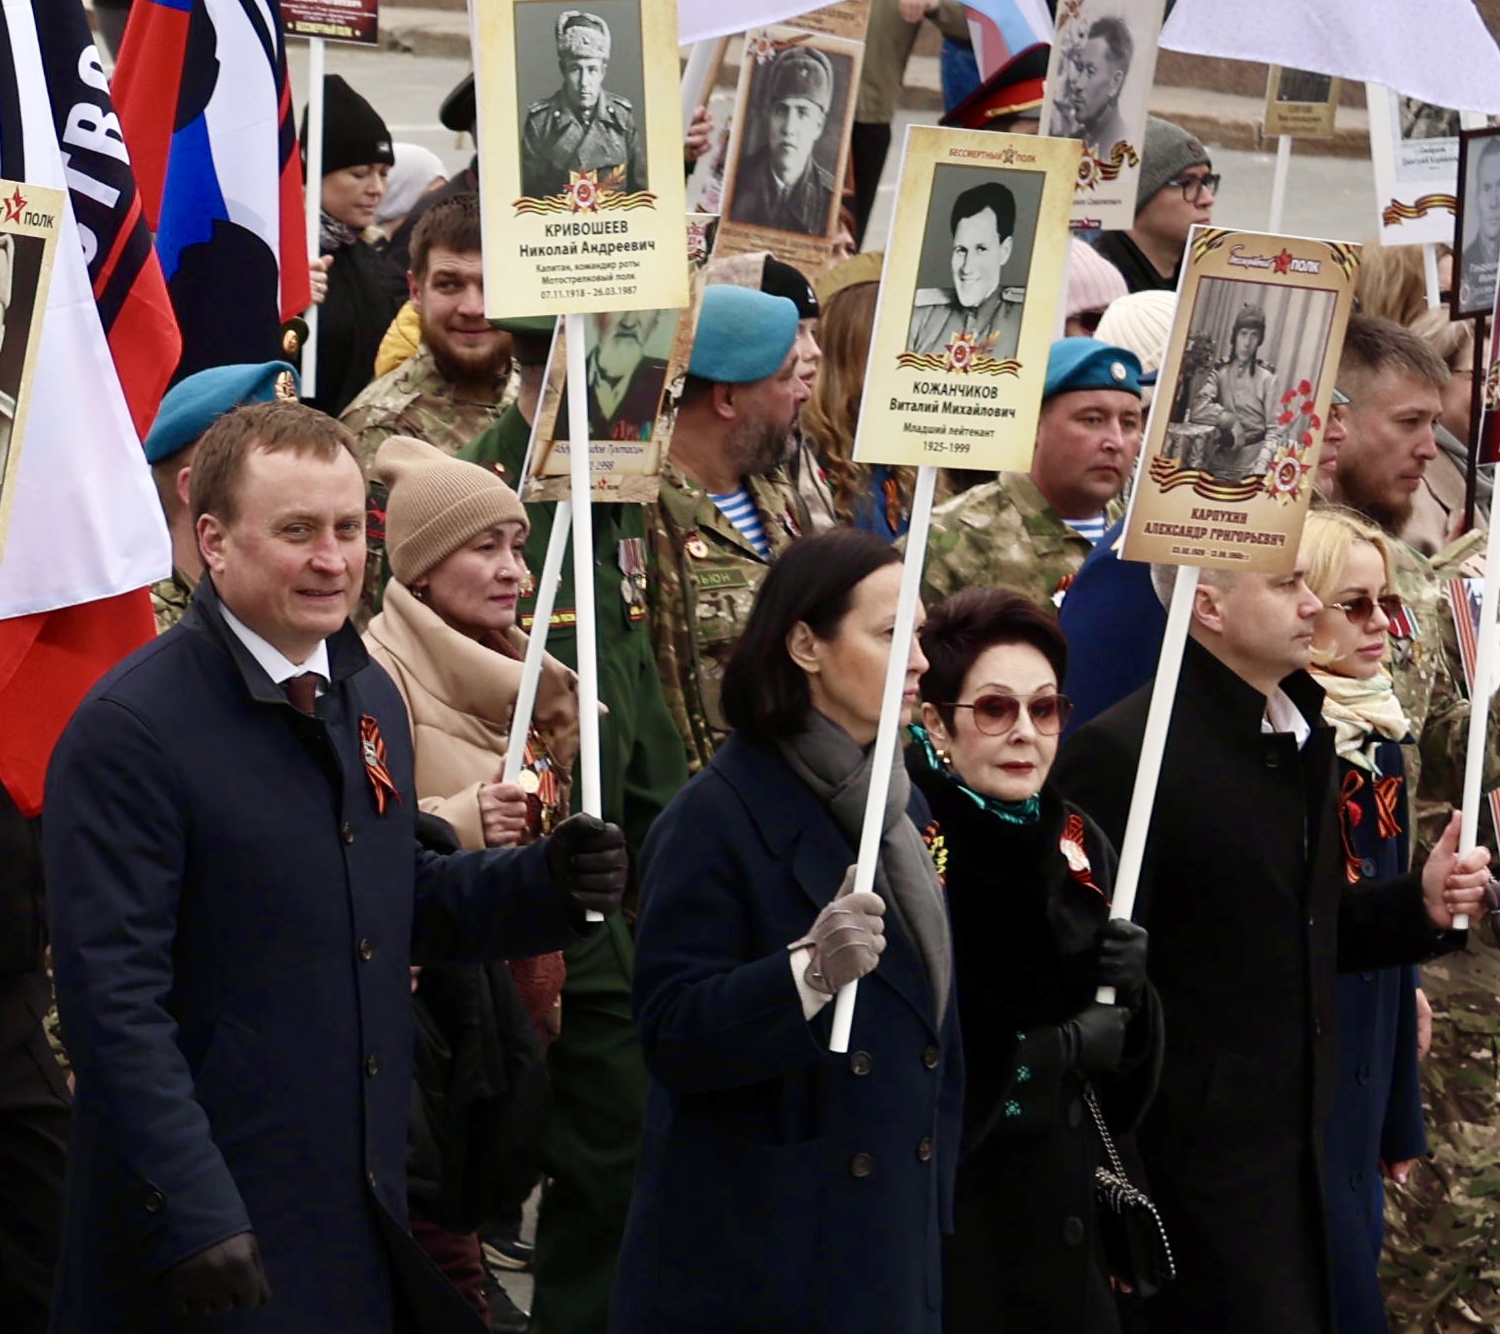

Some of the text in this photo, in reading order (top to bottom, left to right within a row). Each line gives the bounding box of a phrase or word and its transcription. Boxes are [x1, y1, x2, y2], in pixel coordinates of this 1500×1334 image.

[23, 211, 55, 229] ПОЛК
[544, 220, 628, 238] КРИВОШЕЕВ
[519, 240, 656, 257] Николай Андреевич
[1289, 257, 1320, 274] ПОЛК
[912, 381, 999, 399] КОЖАНЧИКОВ
[889, 397, 1016, 418] Виталий Михайлович
[903, 422, 947, 436] Младший
[1190, 508, 1248, 525] КАРПУХИН
[1143, 522, 1286, 547] АЛЕКСАНДР ГРИГОРЬЕВИЧ
